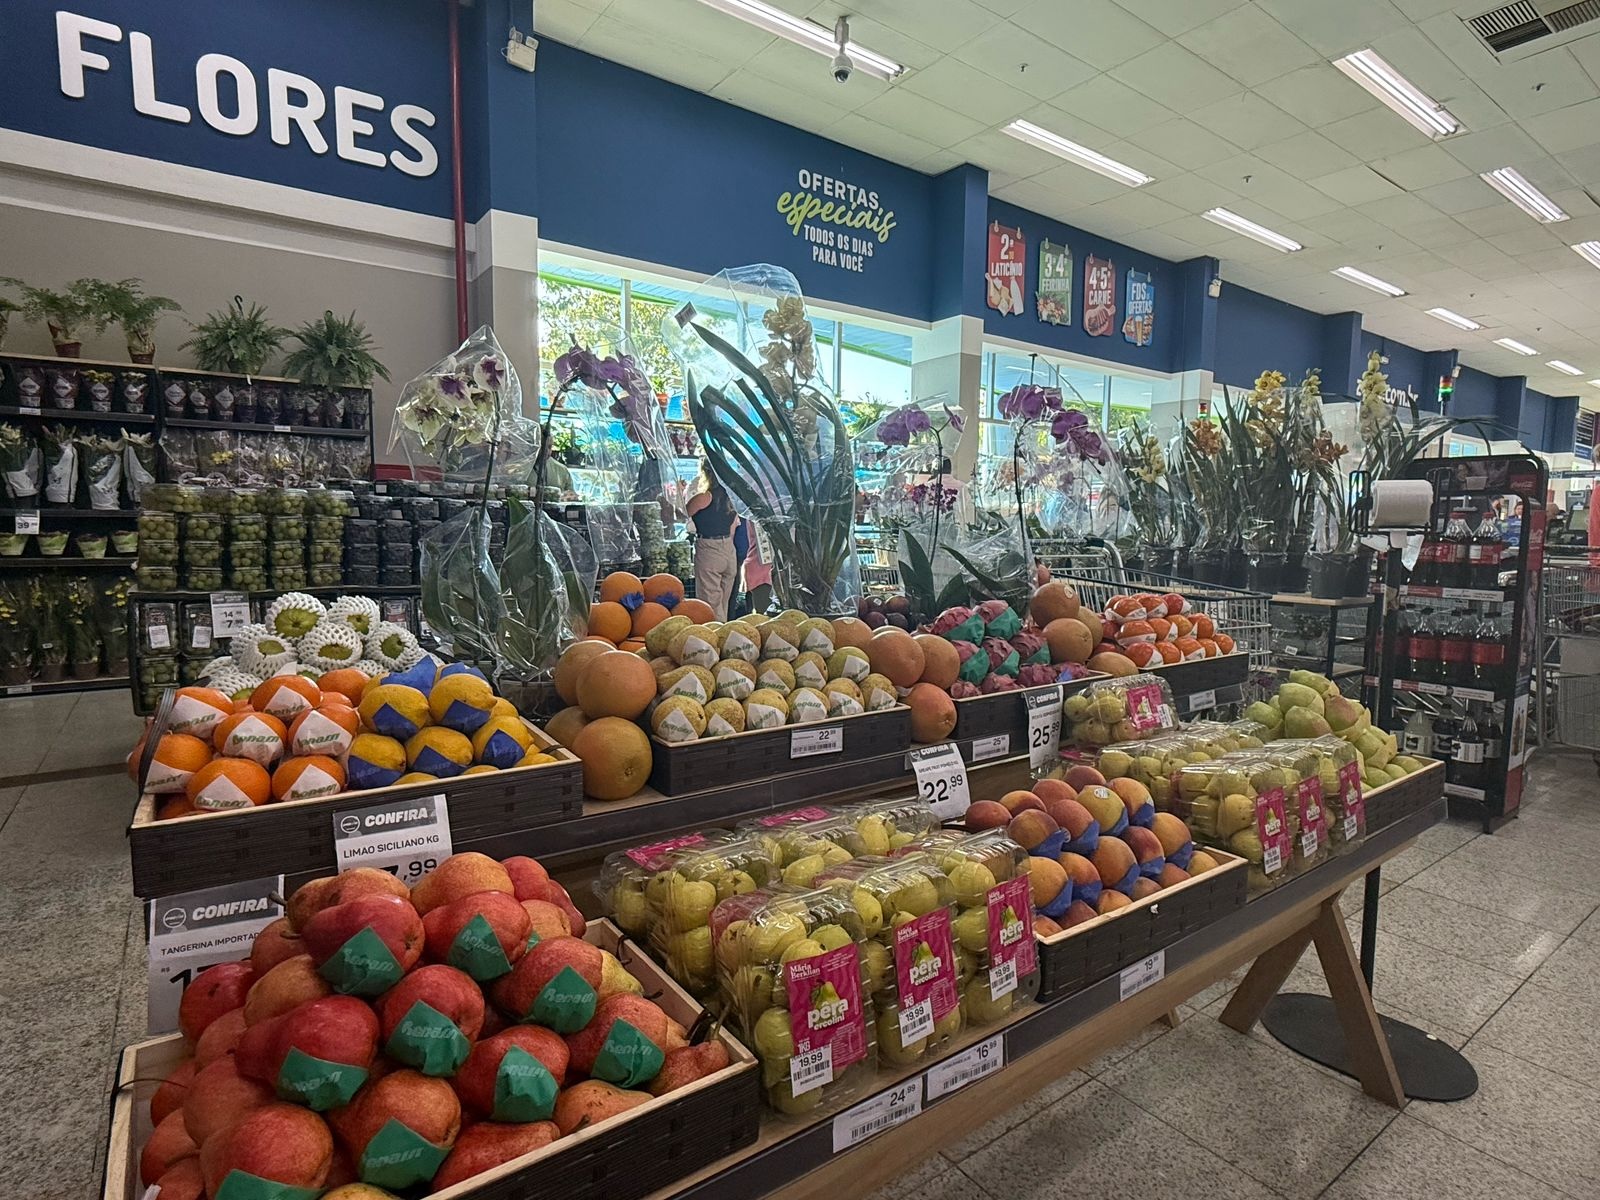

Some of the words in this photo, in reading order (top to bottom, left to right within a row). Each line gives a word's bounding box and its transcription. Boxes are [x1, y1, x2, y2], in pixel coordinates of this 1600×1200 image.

[56, 11, 439, 178] FLORES
[798, 168, 879, 210] OFERTAS
[776, 191, 897, 243] especiais
[803, 224, 835, 248] TODOS
[837, 233, 849, 251] OS
[852, 237, 874, 257] DIAS
[812, 245, 837, 266] PARA
[840, 252, 864, 273] VOCÊ
[1088, 290, 1112, 306] CARNE
[1131, 282, 1147, 301] FDS
[364, 807, 429, 828] CONFIRA
[343, 845, 376, 859] LIMAO
[377, 837, 426, 853] SICILIANO
[426, 834, 440, 844] KG
[192, 897, 269, 922] CONFIRA
[1000, 920, 1024, 945] pêra
[161, 940, 214, 956] TANGERINA
[909, 956, 942, 985] pêra
[807, 998, 849, 1030] pêra
[813, 1012, 845, 1031] ercolini
